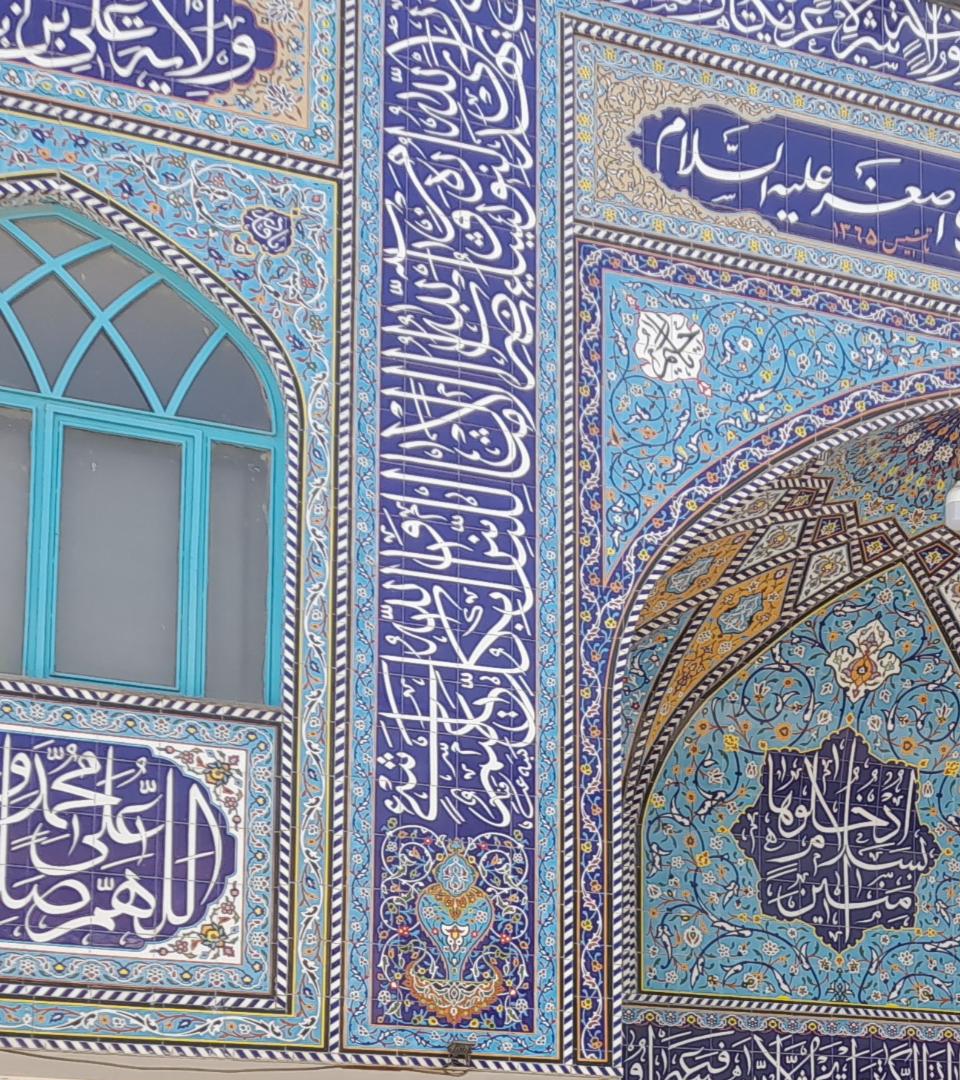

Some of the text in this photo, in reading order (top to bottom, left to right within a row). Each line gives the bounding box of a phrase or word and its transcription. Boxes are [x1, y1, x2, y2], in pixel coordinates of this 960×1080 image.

[656, 116, 784, 207] السلام
[766, 157, 833, 223] علیه
[811, 177, 957, 244] اصغر
[832, 221, 880, 246] ۱۳۶۵
